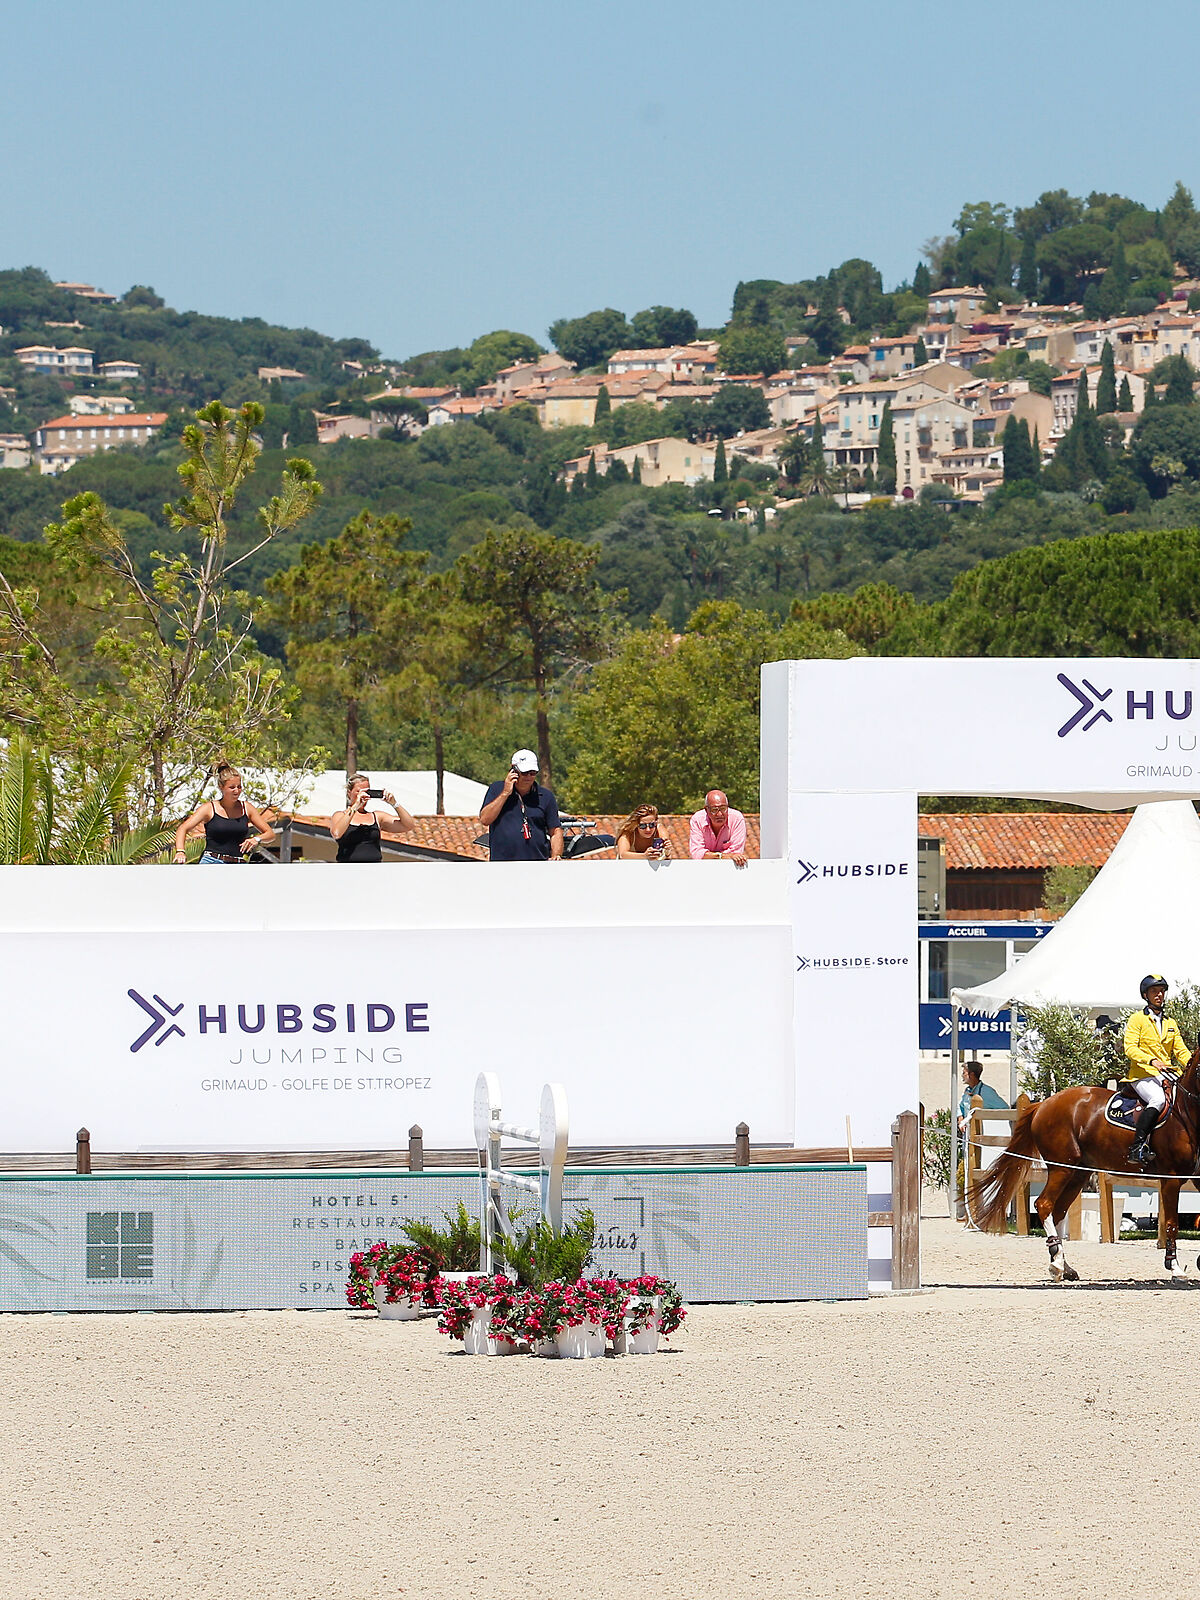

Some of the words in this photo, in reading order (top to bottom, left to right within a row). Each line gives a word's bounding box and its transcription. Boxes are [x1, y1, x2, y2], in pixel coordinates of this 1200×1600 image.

[1126, 764, 1193, 778] GRIMAUD
[822, 863, 909, 877] HUBSIDE
[947, 927, 988, 936] ACCUEIL
[198, 1003, 430, 1034] HUBSIDE
[229, 1047, 403, 1064] JUMPING
[200, 1078, 268, 1091] GRIMAUD
[281, 1078, 329, 1091] GOLFE
[333, 1078, 353, 1091] DE
[312, 1196, 378, 1207] HOTEL
[299, 1282, 335, 1293] SPA
